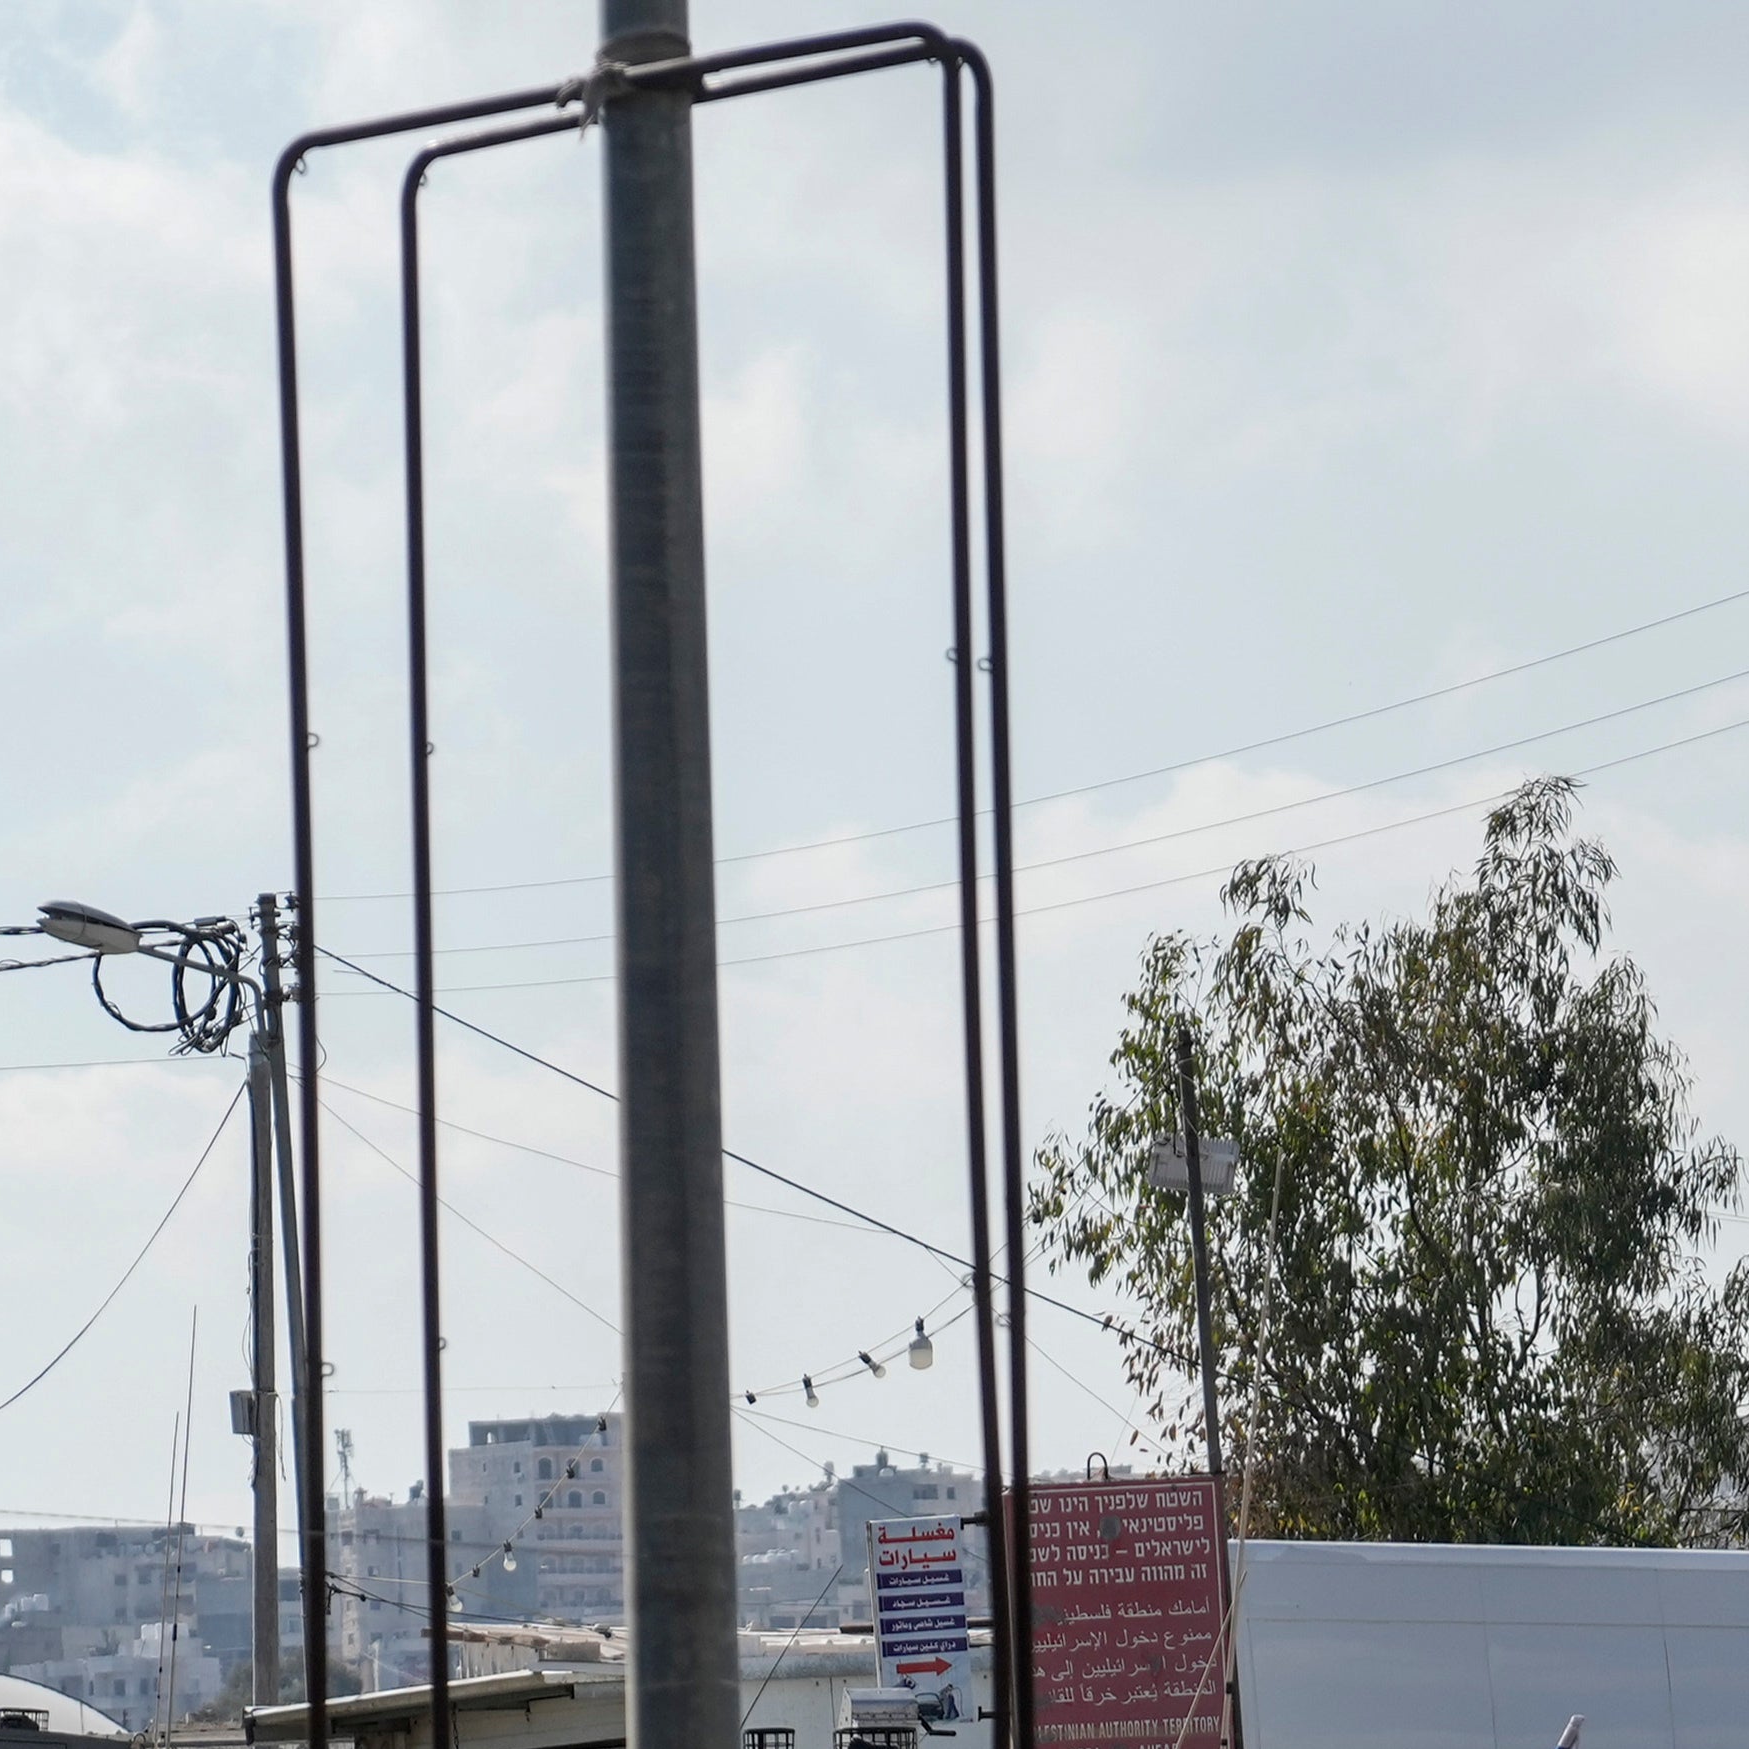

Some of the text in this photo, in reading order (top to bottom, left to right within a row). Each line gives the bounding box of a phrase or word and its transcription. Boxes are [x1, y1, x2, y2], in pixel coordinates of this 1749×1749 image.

[1058, 1496, 1090, 1513] הינו
[1094, 1491, 1149, 1514] שלפניך
[1155, 1490, 1202, 1508] השטח
[877, 1521, 955, 1545] مغسلة
[1030, 1521, 1060, 1538] כניס
[1066, 1520, 1090, 1540] אין
[1134, 1537, 1211, 1558] לישראלים
[879, 1548, 957, 1570] سيارات
[1062, 1568, 1083, 1585] על
[1089, 1567, 1135, 1584] עבירה
[1190, 1563, 1208, 1579] זה
[1099, 1719, 1159, 1738] AUTHORITY
